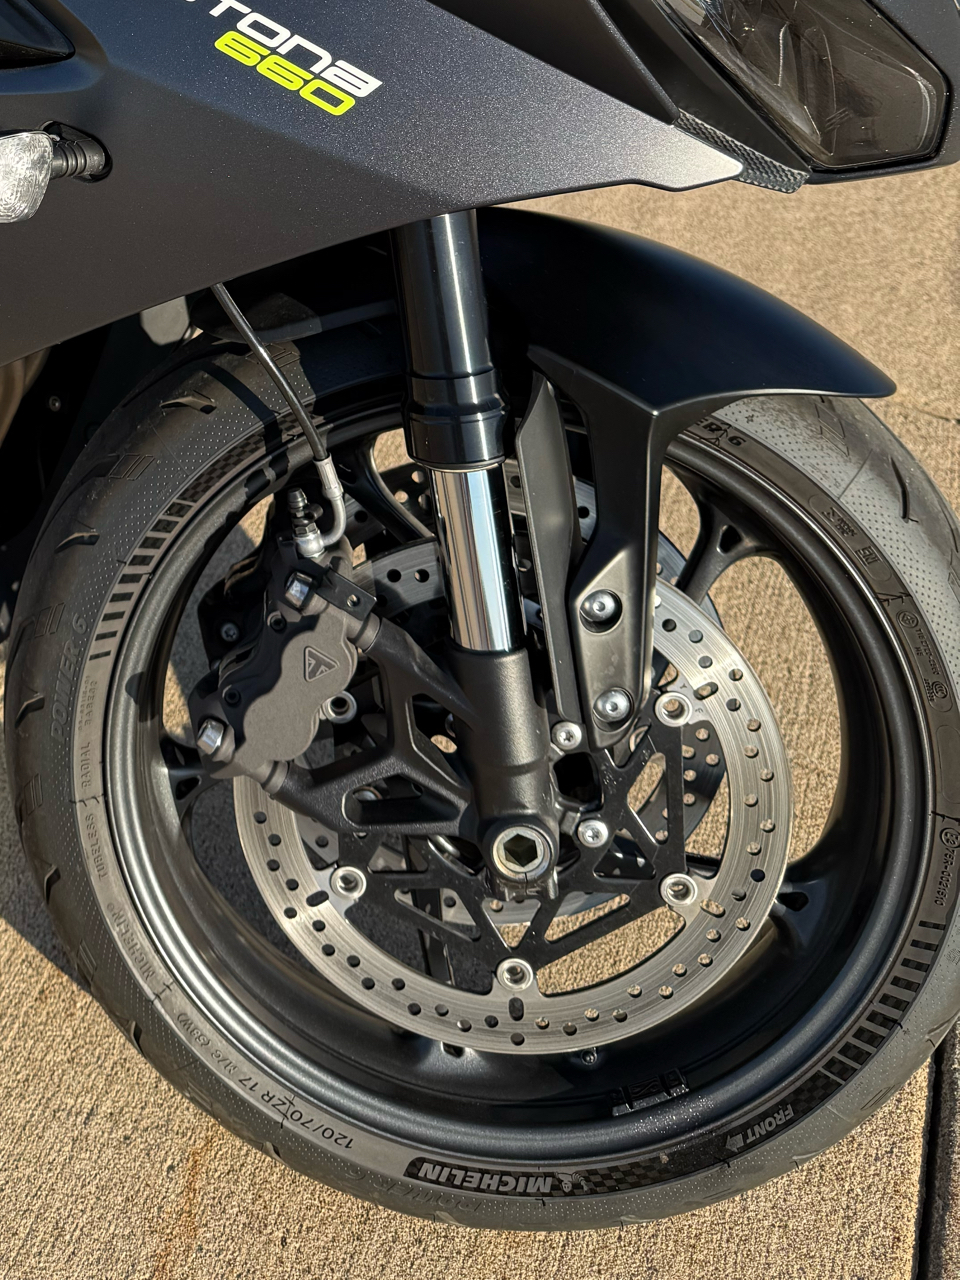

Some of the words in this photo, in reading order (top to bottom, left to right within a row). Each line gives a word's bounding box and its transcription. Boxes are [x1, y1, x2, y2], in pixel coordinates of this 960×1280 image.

[214, 30, 356, 116] 660
[50, 639, 81, 743] POWER
[72, 613, 88, 635] 6
[80, 741, 91, 789] RADIAL
[85, 813, 109, 881] TUBELESS
[210, 1049, 238, 1075] M/C
[238, 1075, 259, 1092] 17
[260, 1090, 288, 1116] ZR
[290, 1109, 354, 1149] 120/70
[744, 1104, 795, 1144] FRONT
[418, 1162, 553, 1193] MICHELIN
